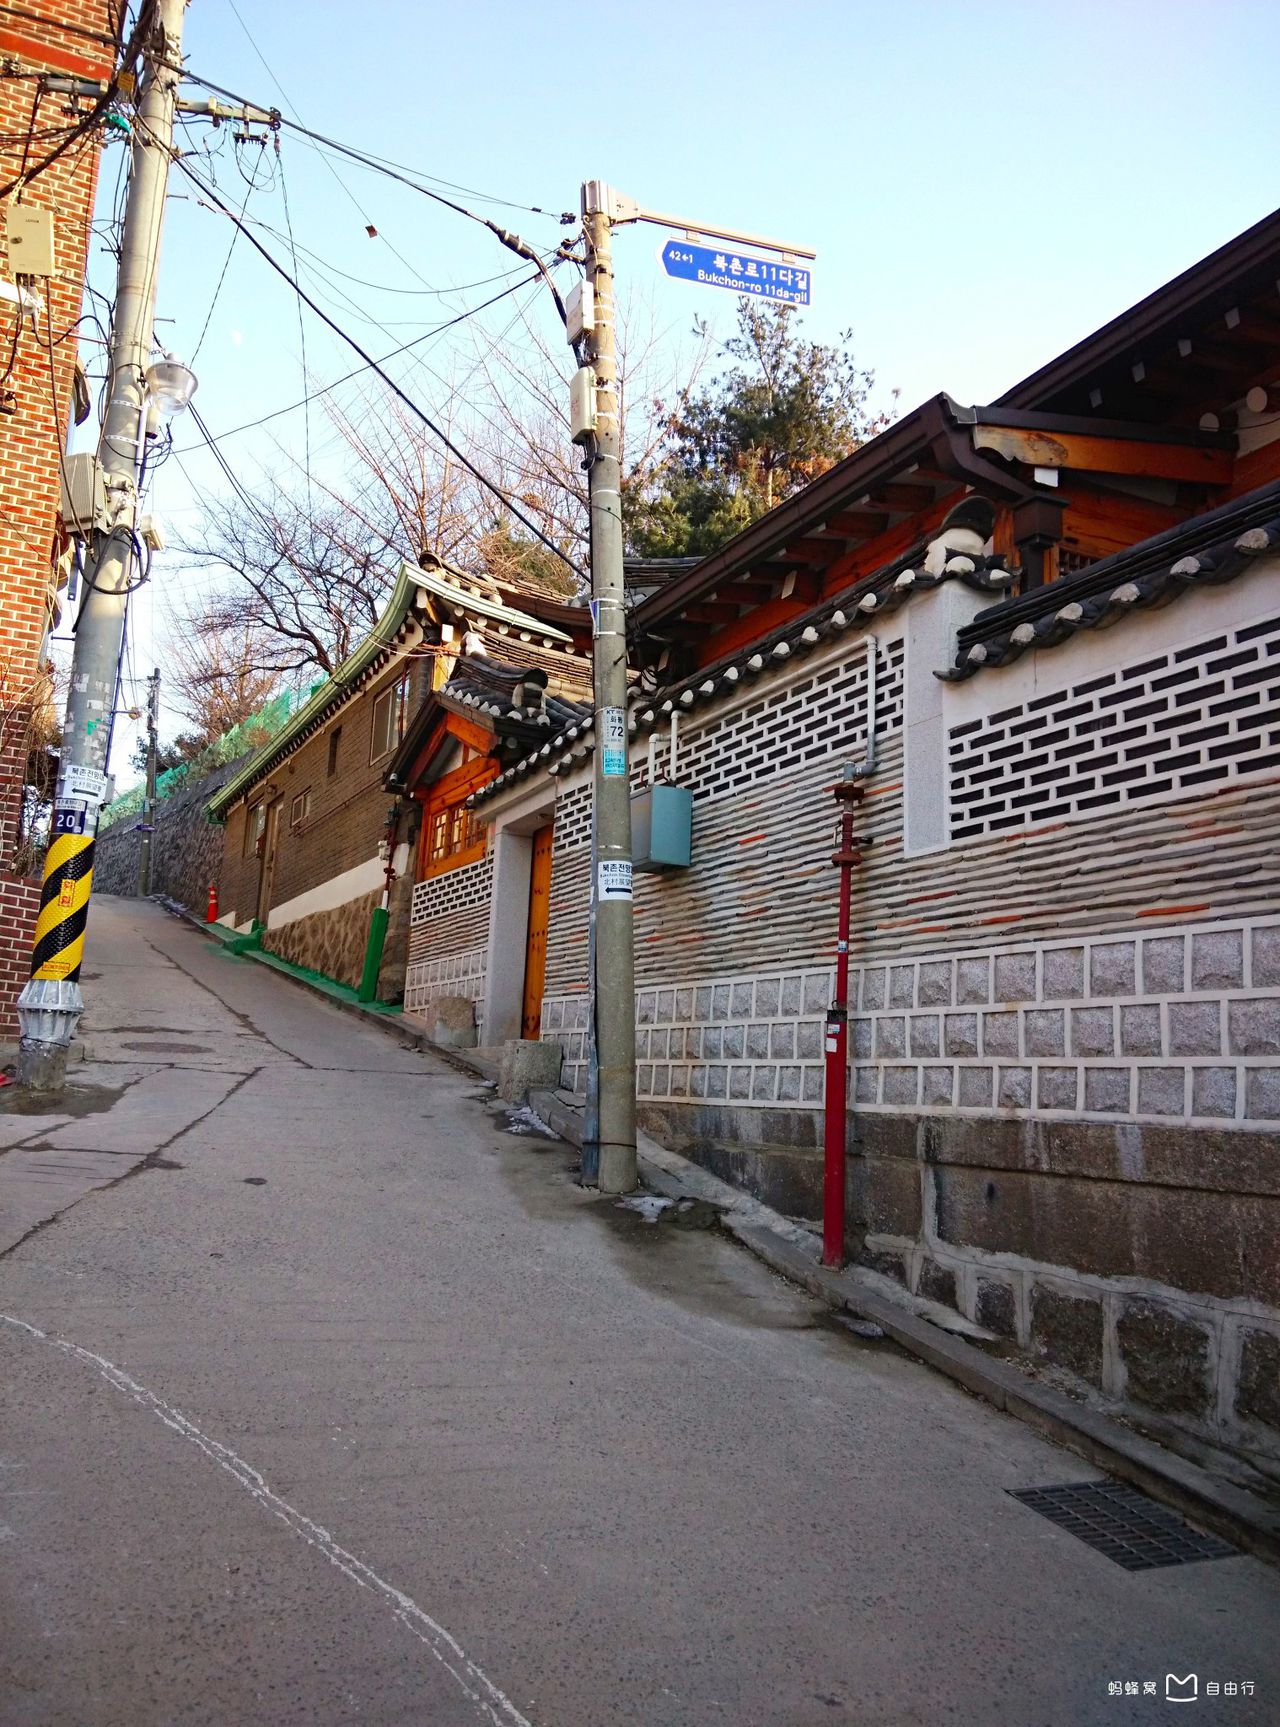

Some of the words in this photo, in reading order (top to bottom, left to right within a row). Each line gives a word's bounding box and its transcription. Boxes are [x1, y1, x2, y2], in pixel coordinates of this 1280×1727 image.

[713, 253, 808, 290] 북촌로11다길
[697, 269, 762, 293] Bukchon-ro
[764, 284, 808, 303] 11da-gil
[610, 725, 624, 737] 72
[56, 814, 76, 827] 20
[602, 863, 632, 874] 북촌전망
